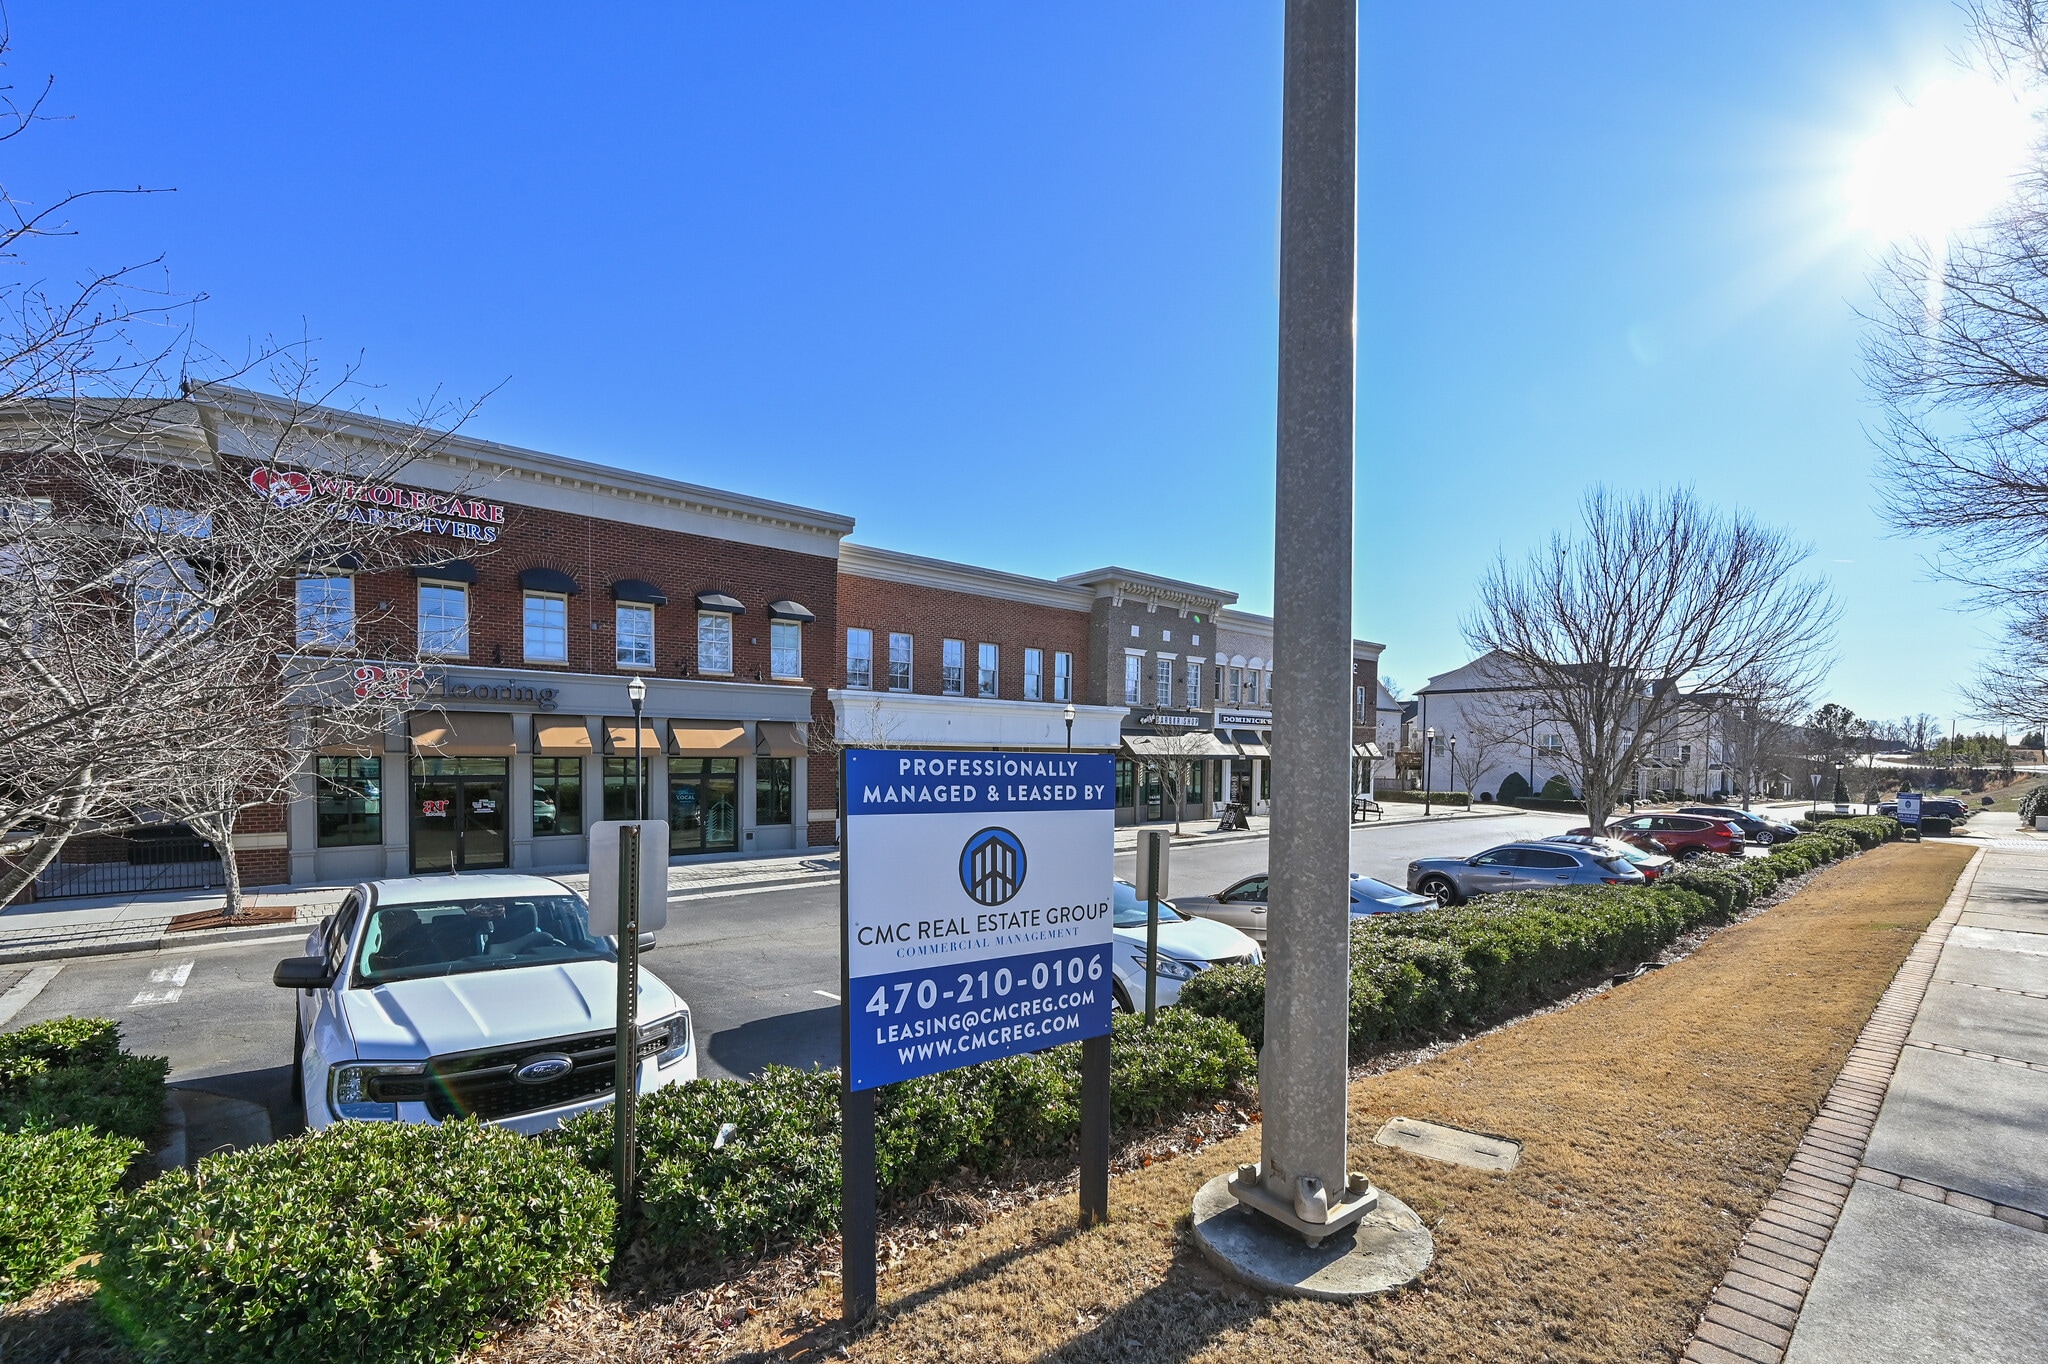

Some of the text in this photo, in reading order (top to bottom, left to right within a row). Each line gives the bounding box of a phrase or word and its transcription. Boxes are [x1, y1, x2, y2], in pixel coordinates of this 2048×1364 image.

[313, 474, 505, 524] WHOLECARE
[326, 503, 497, 542] CAREGIVERS
[899, 758, 1078, 777] PROFESSIONALLY
[862, 784, 1105, 803] MANAGED & LEASED BY
[857, 902, 1109, 946] CMC REAL ESTATE GROUP
[896, 926, 1080, 959] COMMERCIAL MANAGEMENT
[865, 953, 1103, 1017] 470-210-0106
[876, 989, 1095, 1045] LEASING@CMCREG.COM
[898, 1013, 1080, 1066] WWW.CMCREG.COM
